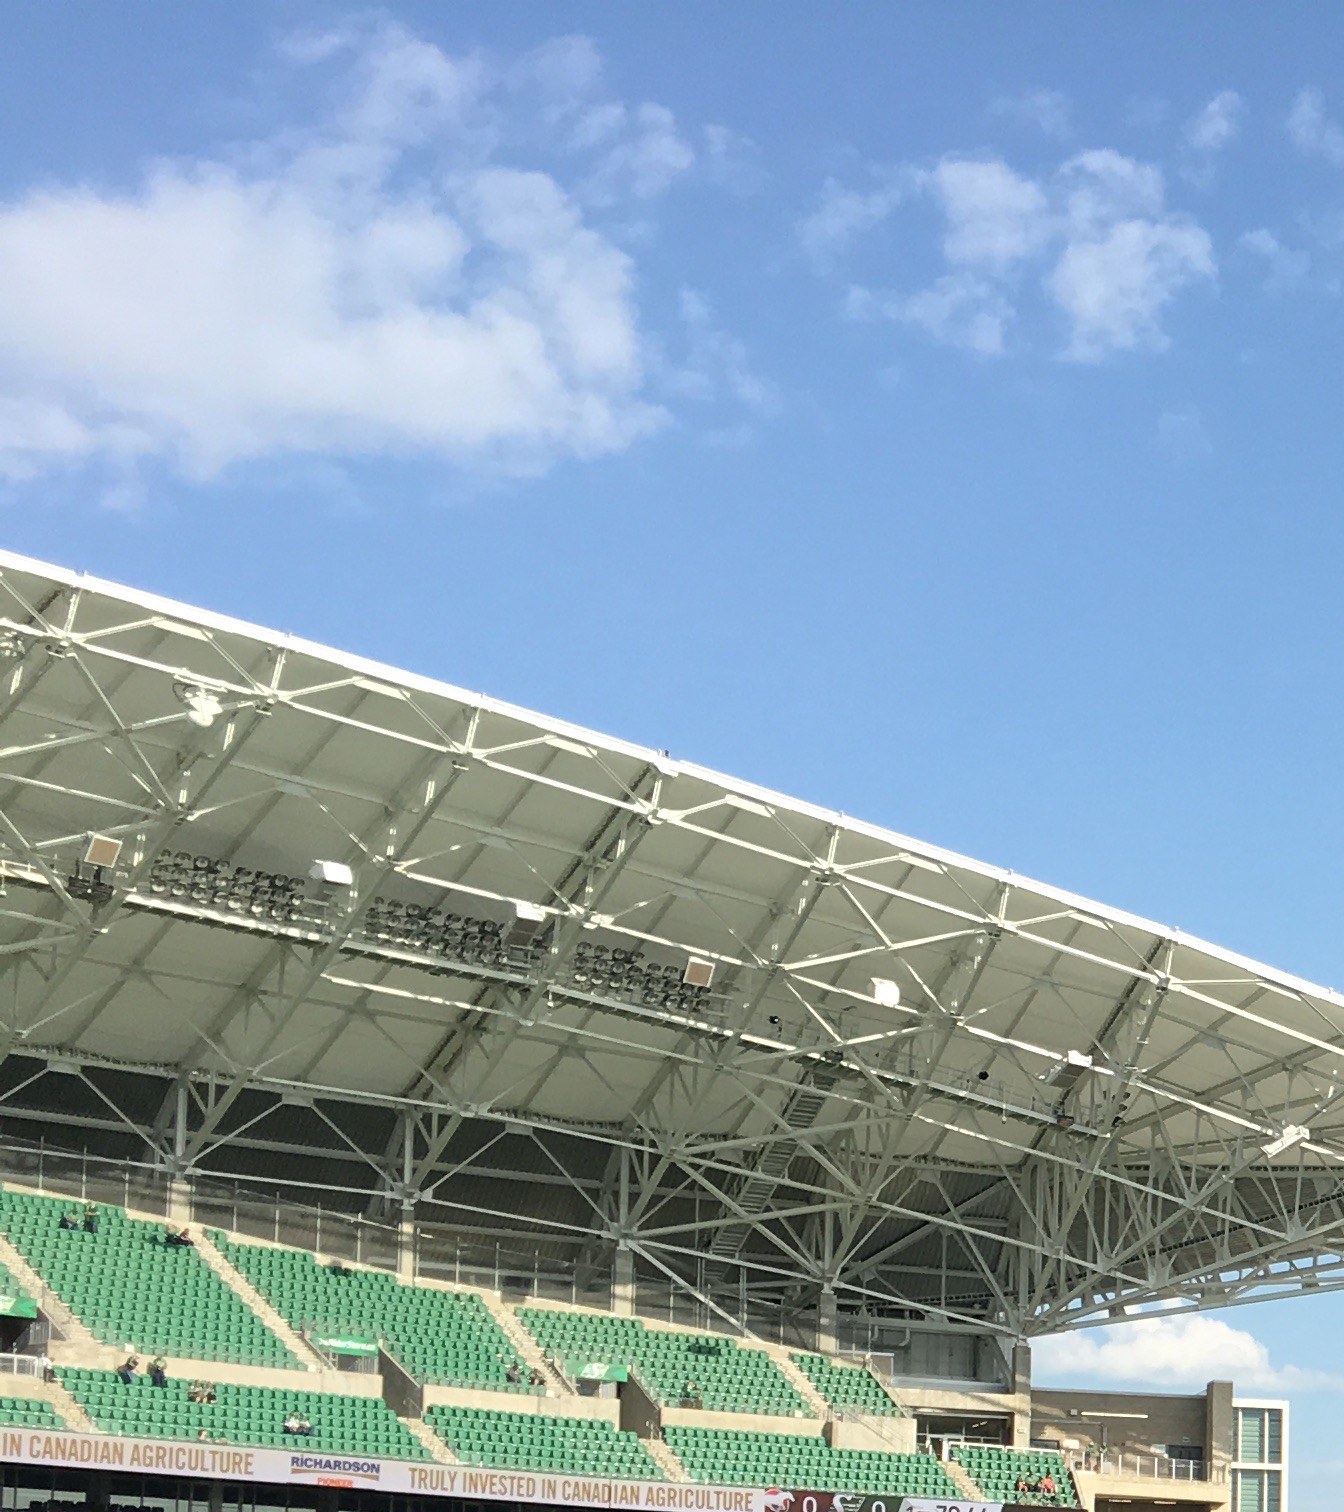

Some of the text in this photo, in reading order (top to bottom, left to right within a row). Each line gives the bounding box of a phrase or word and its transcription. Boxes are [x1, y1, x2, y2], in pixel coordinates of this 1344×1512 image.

[2, 1432, 254, 1475] IN CANADIAN AGRICULTURE
[408, 1467, 754, 1512] TRULY INVESTED IN CANADIAN AGRICULTURE
